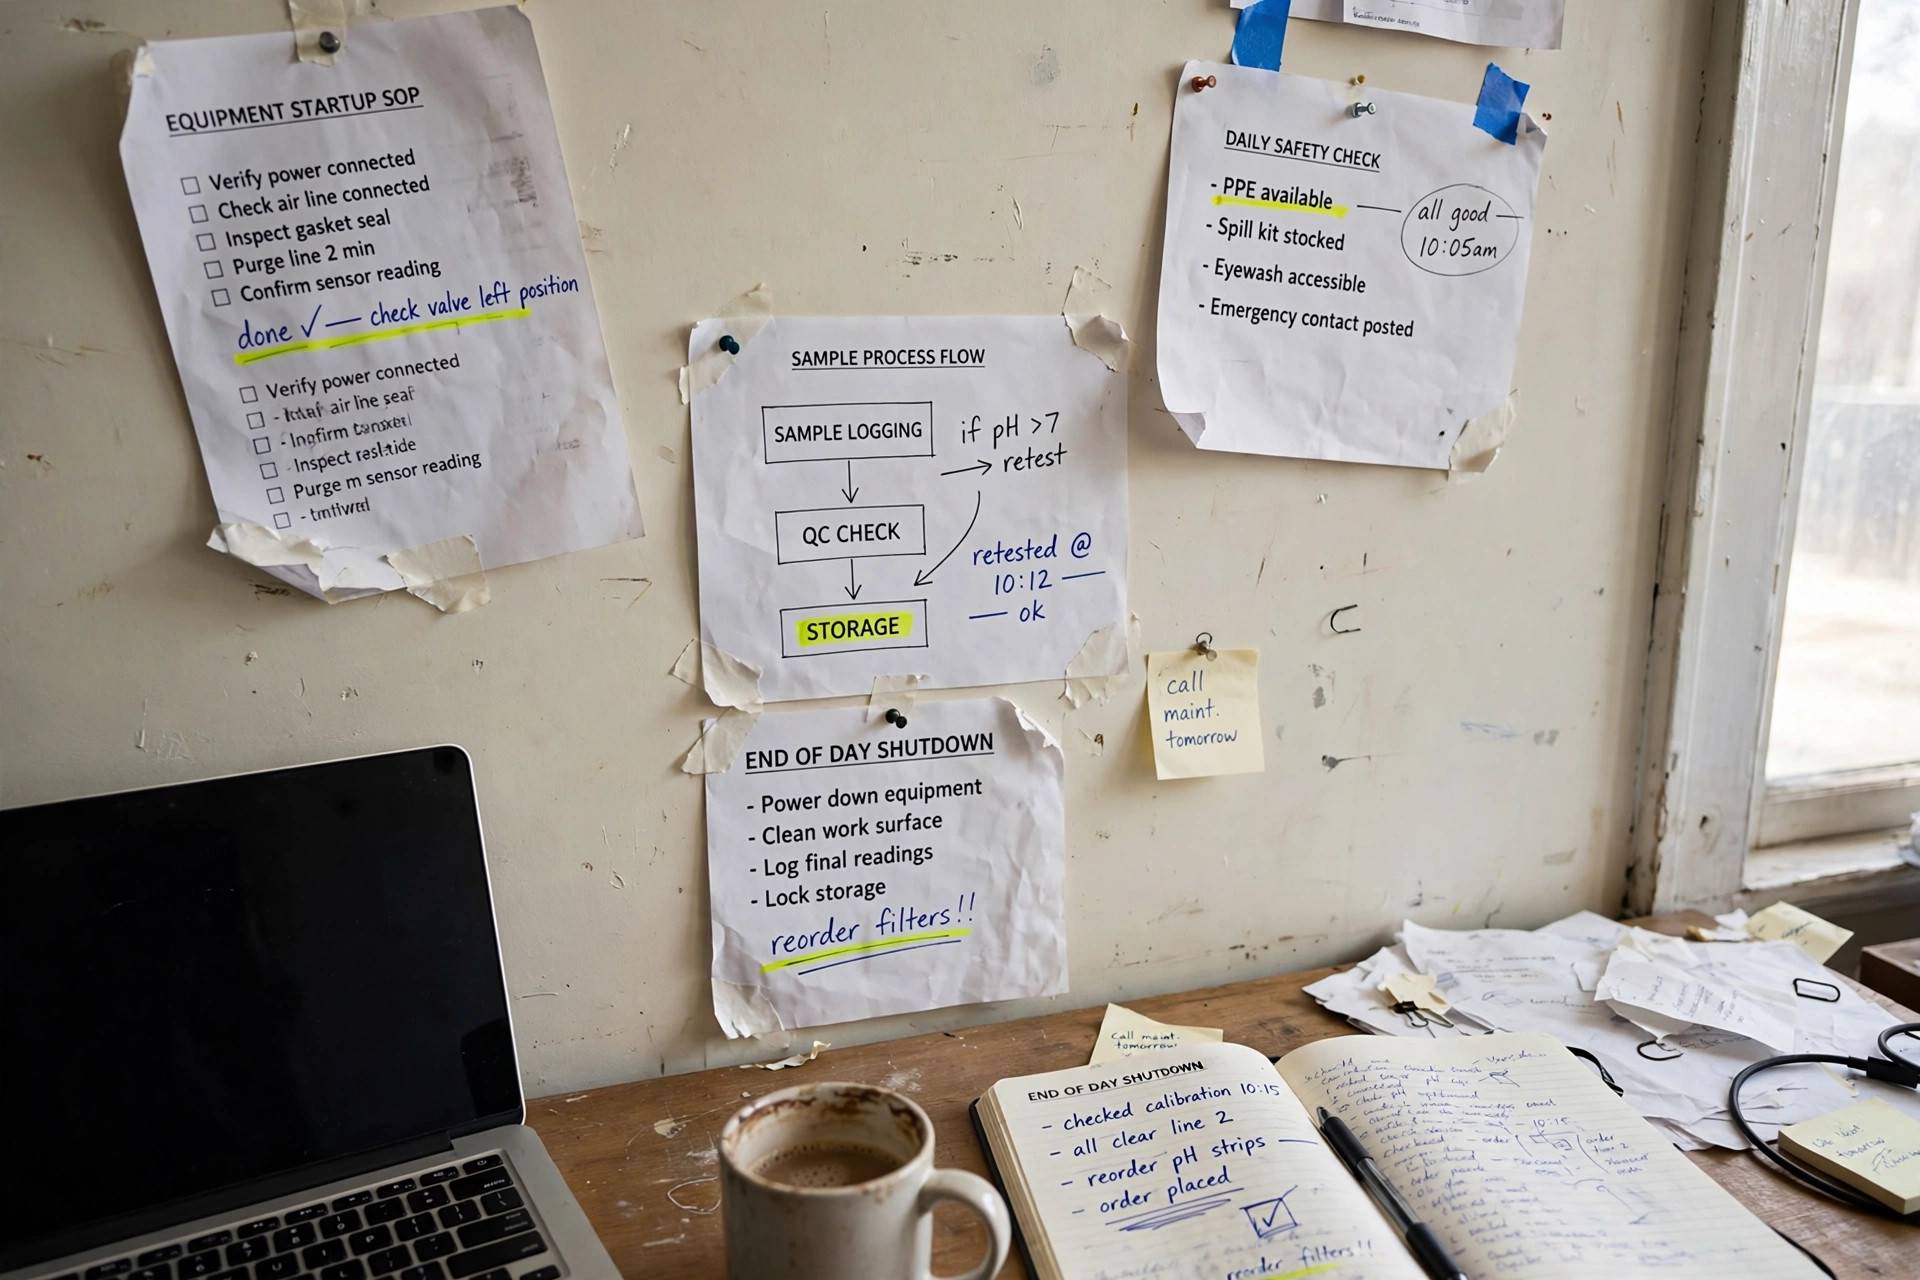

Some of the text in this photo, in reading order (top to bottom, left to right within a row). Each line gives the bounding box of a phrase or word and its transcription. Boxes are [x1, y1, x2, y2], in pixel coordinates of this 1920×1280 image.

[165, 86, 421, 132] EQUIPMENT STARTUP SOP
[1225, 129, 1381, 170] DAILY SAFETY CHECK
[209, 149, 416, 193] Verify power connected
[218, 175, 430, 219] Check air line connected
[1223, 176, 1333, 211] PPE available
[225, 209, 392, 249] Inspect gasket seal
[1417, 198, 1489, 232] all good
[1217, 217, 1345, 252] Spill kit stocked
[1420, 237, 1498, 260] 10:05am
[233, 239, 376, 280] Purge line 2 min
[1214, 257, 1367, 294] Eyewash accessible
[240, 258, 441, 302] Confirm sensor reading
[237, 276, 579, 349] done check valve left position
[1210, 297, 1414, 338] Emergency contact posted
[791, 348, 986, 368] SAMPLE PROCESS FLOW
[266, 353, 461, 400] Verify power connected
[330, 398, 351, 415] air
[774, 421, 923, 443] SAMPLE LOGGING
[961, 415, 982, 444] if
[992, 414, 1019, 450] pH
[294, 451, 351, 473] Inspect
[1003, 442, 1068, 474] retest
[293, 453, 482, 499] Purge m sensor reading
[802, 521, 901, 546] QC CHECK
[973, 531, 1093, 566] retested @
[994, 568, 1052, 596] 10:12
[1019, 599, 1046, 623] ok
[806, 616, 900, 642] STORAGE
[1167, 670, 1203, 694] call
[1164, 698, 1220, 722] maint.
[746, 733, 994, 770] END OF DAY SHUTDOWN
[1165, 729, 1237, 749] tomorrow
[761, 779, 983, 813] Power down equipment
[762, 813, 943, 845] Clean work surface
[764, 844, 934, 879] Log final readings
[766, 880, 887, 907] Lock storage
[771, 891, 976, 955] reorder filters!!
[1028, 1060, 1204, 1103] END OF DAY SHUTDOWN
[1063, 1082, 1280, 1131] checked calibration 10:15
[1073, 1111, 1234, 1158] all clear line 2
[1088, 1135, 1267, 1188] reorder pH strips
[1100, 1166, 1232, 1214] order placed
[1297, 1240, 1373, 1269] filters!!
